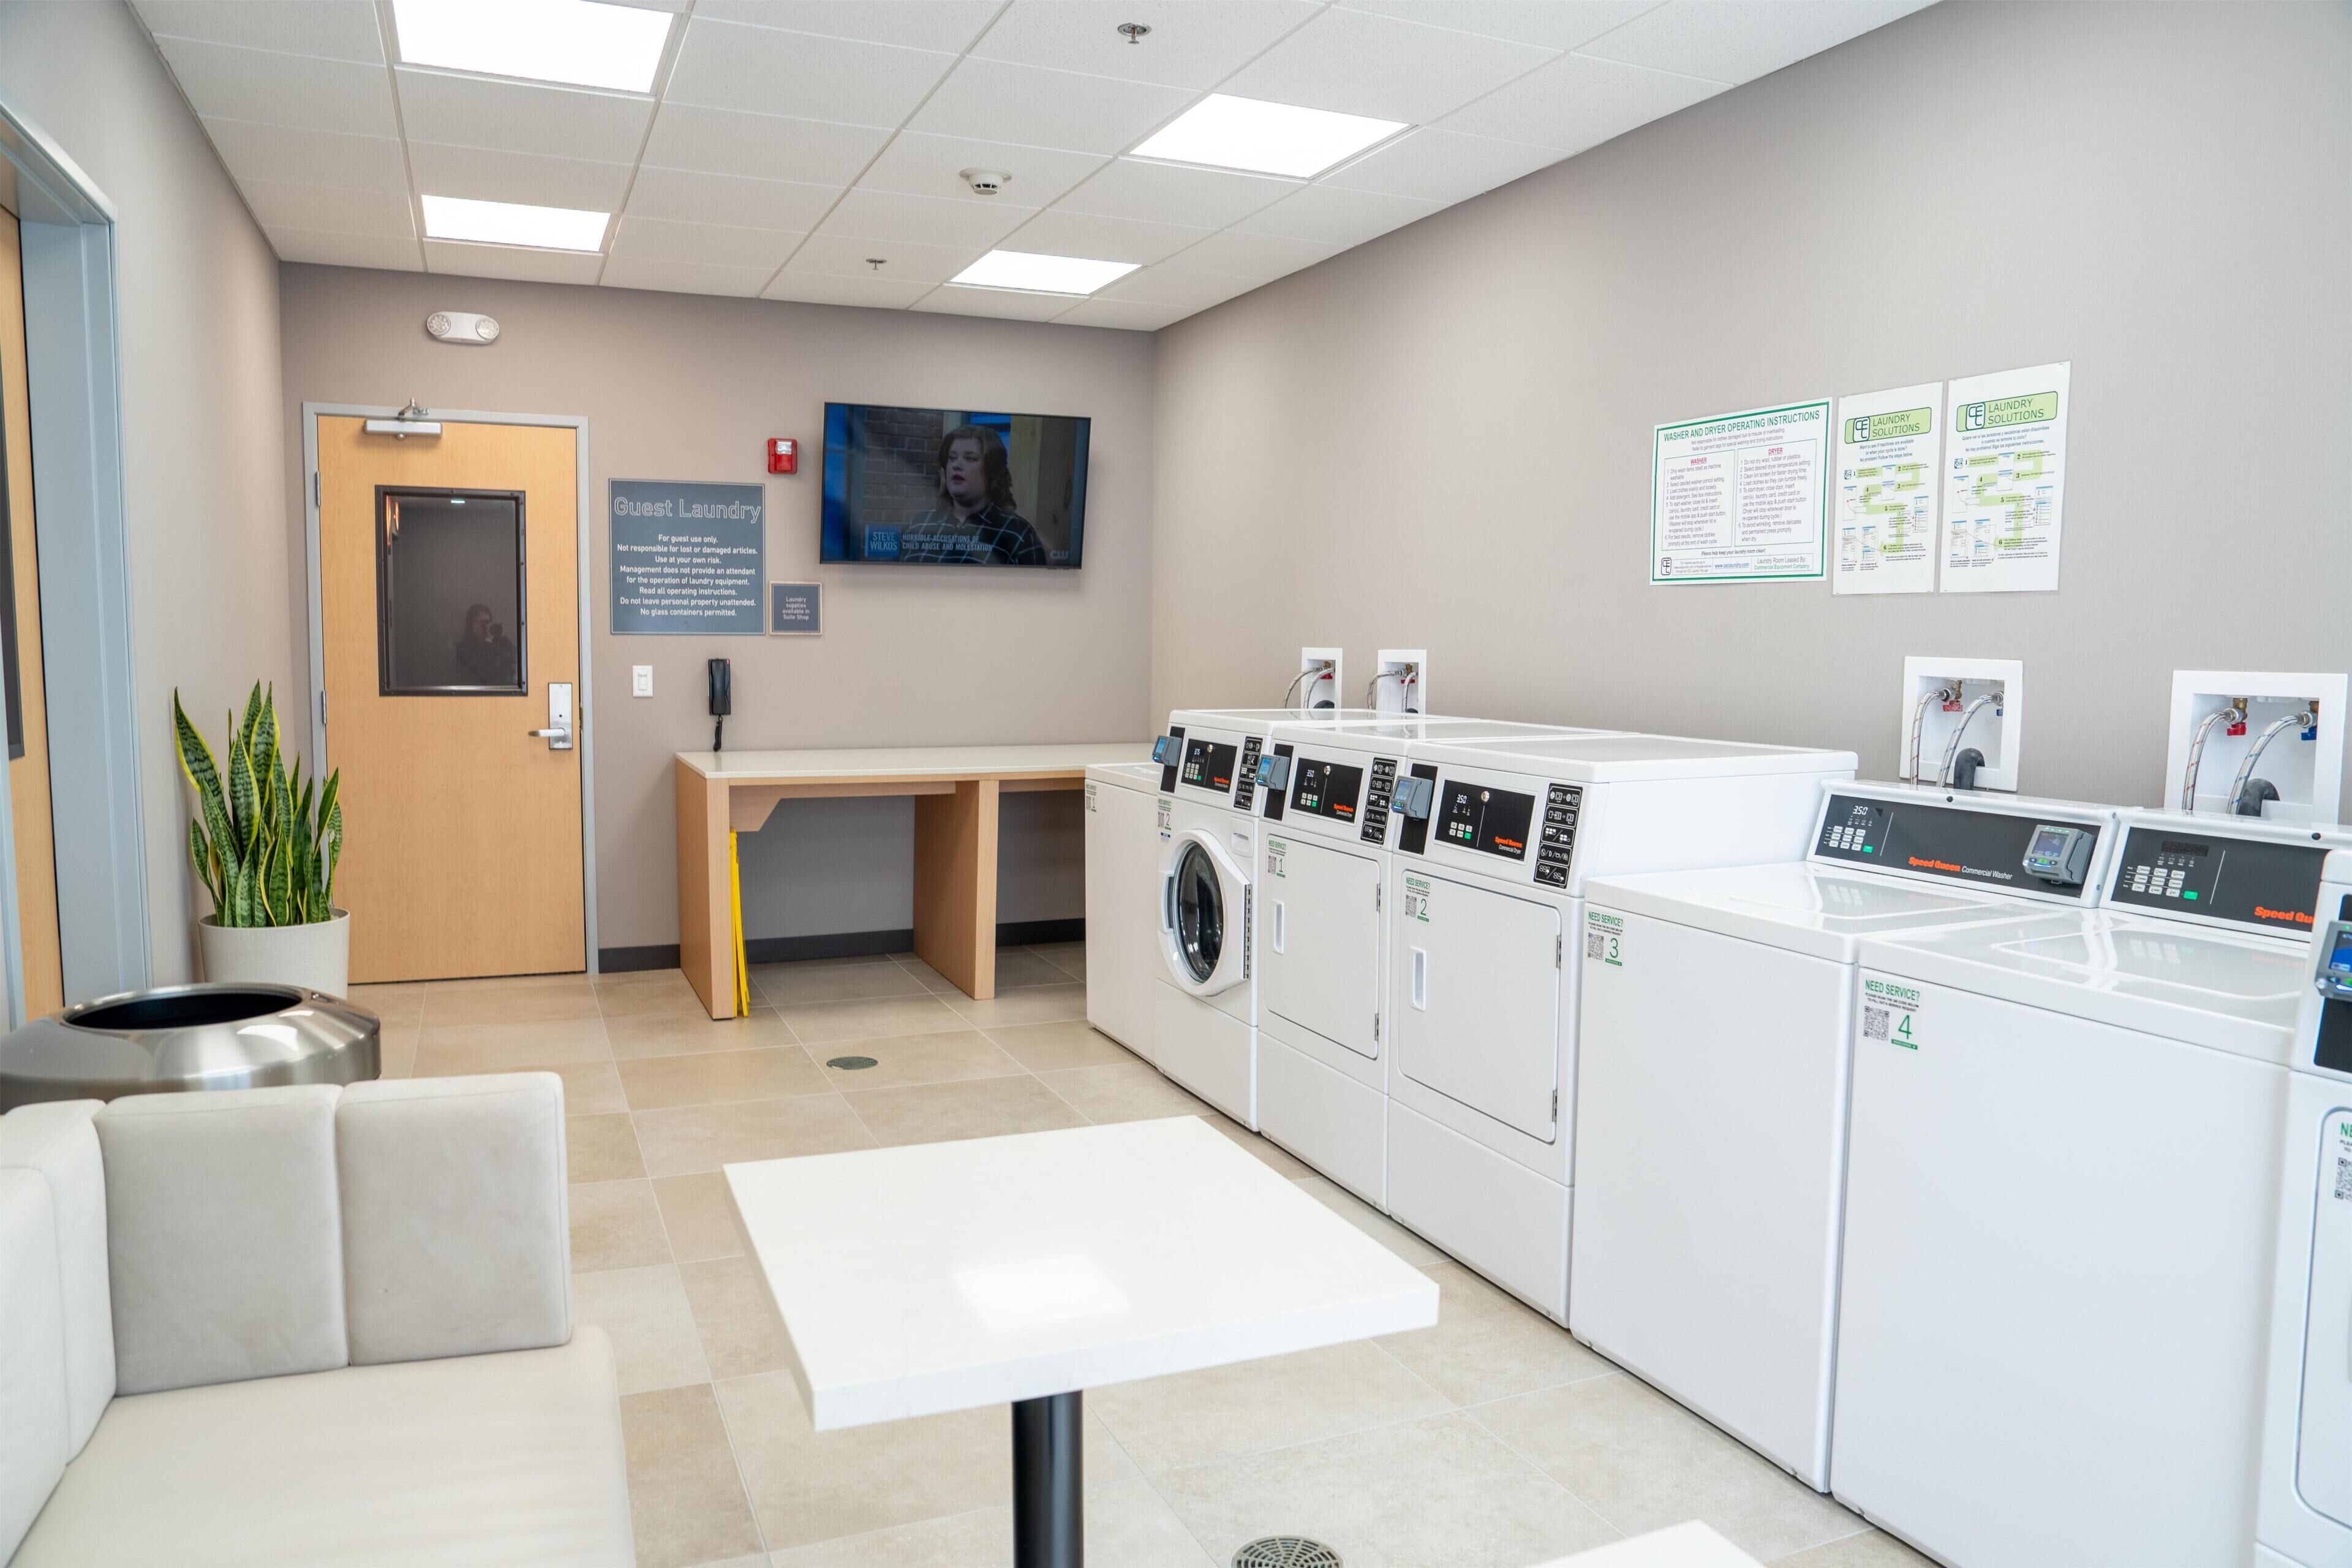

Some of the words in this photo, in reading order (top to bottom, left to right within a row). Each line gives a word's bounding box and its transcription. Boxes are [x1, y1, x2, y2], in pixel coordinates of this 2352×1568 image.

[1989, 398, 2033, 413] LAUNDRY
[1873, 413, 1910, 426] LAUNDRY
[1988, 409, 2043, 424] SOLUTIONS
[1664, 430, 1689, 441] WASHER
[1690, 428, 1703, 437] AND
[1705, 424, 1725, 435] DRYER
[1727, 418, 1765, 432] OPERATING
[1767, 410, 1819, 426] INSTRUCTIONS
[1872, 423, 1920, 437] SOLUTIONS
[614, 497, 673, 516] Guest
[679, 499, 761, 524] Laundry
[872, 531, 895, 541] STEVE
[933, 534, 970, 543] ACCUSATIONS
[702, 546, 731, 554] damaged
[870, 541, 897, 551] WILKOS
[620, 565, 661, 574] Management
[667, 587, 696, 596] operating
[651, 608, 668, 616] glass
[1166, 813, 1170, 826] 2
[1279, 858, 1284, 873] 1
[1909, 856, 1934, 868] Speed
[1934, 860, 1961, 872] Queen
[1961, 865, 1992, 876] Commercial
[1992, 870, 2013, 880] Washer
[1406, 876, 1414, 886] NEED
[1420, 898, 1427, 916] 2
[2254, 906, 2295, 921] Speed
[1588, 911, 1600, 922] NEED
[1601, 914, 1623, 927] SERVICE?
[1609, 937, 1619, 959] 3
[1865, 979, 1884, 993] NEED
[1885, 984, 1920, 1001] SERVICE?
[1898, 1014, 1912, 1039] 4
